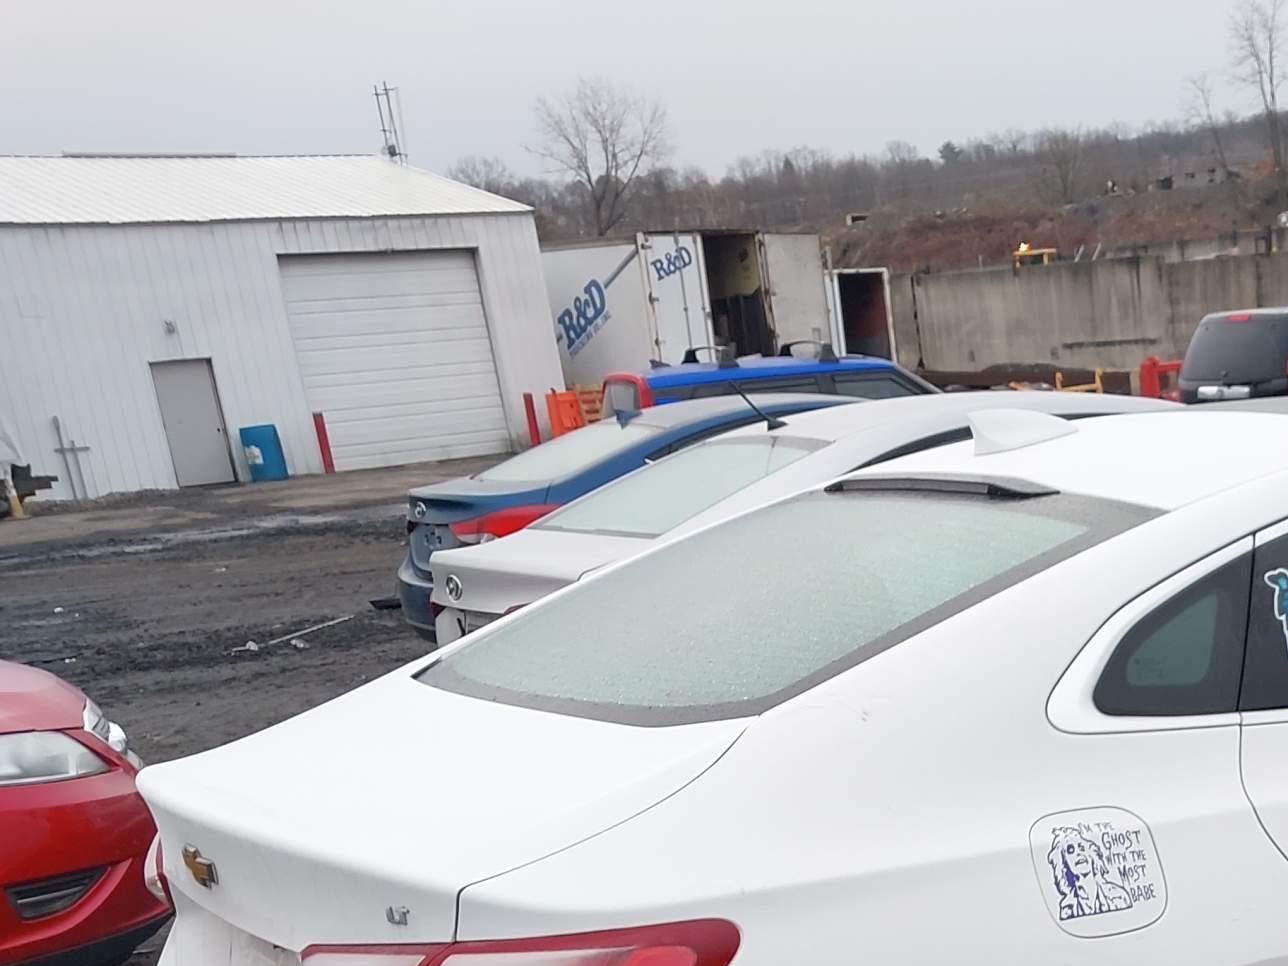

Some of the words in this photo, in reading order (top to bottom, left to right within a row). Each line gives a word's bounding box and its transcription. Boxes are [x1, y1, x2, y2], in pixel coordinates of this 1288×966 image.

[651, 246, 692, 281] R&D
[558, 279, 606, 350] R&D
[1105, 852, 1127, 866] WITH
[1129, 850, 1147, 863] THE
[1130, 884, 1156, 903] BABE
